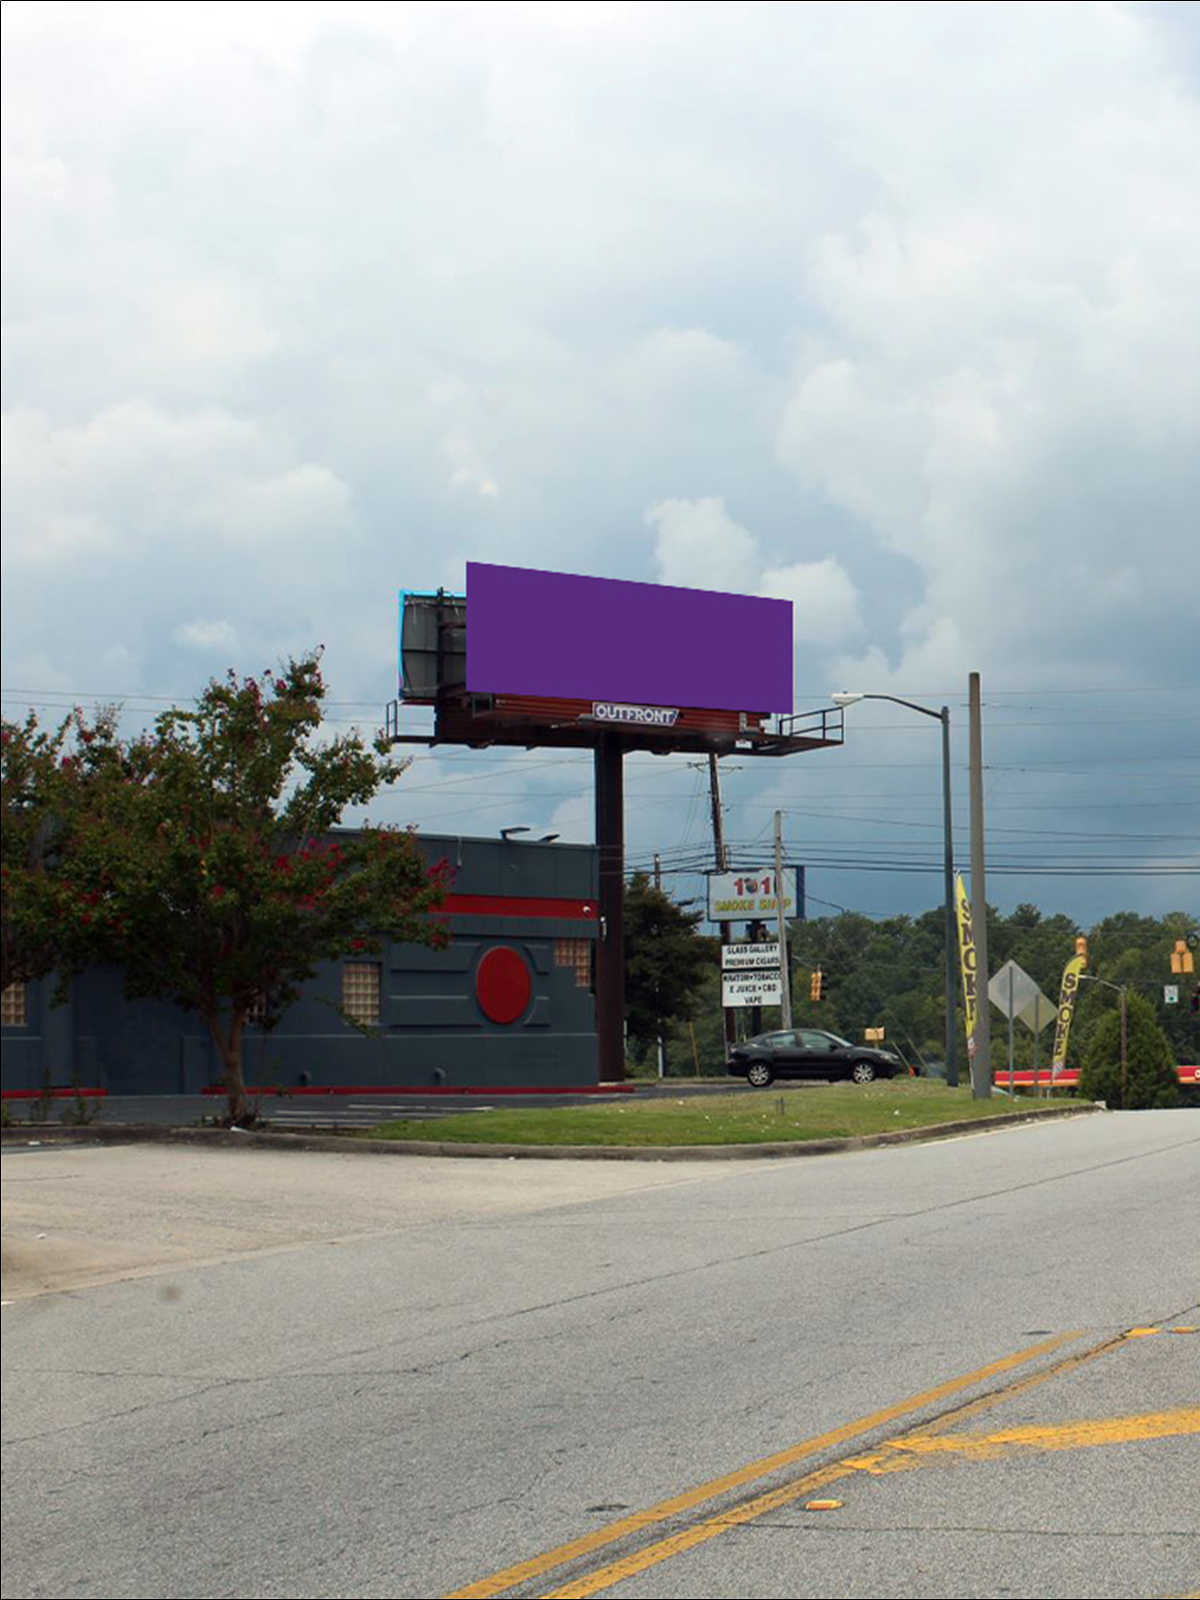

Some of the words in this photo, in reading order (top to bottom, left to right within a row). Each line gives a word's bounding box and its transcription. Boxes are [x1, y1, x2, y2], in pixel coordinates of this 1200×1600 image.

[596, 705, 675, 723] OUTFRONT
[714, 899, 755, 912] SMOKE
[759, 898, 792, 910] SHP
[727, 945, 748, 954] GLASS
[749, 945, 777, 953] GALLERY
[725, 958, 755, 966] PREMIUM
[736, 985, 757, 993] JUICE
[744, 996, 762, 1004] VAPE
[1055, 972, 1076, 1056] SMOKE
